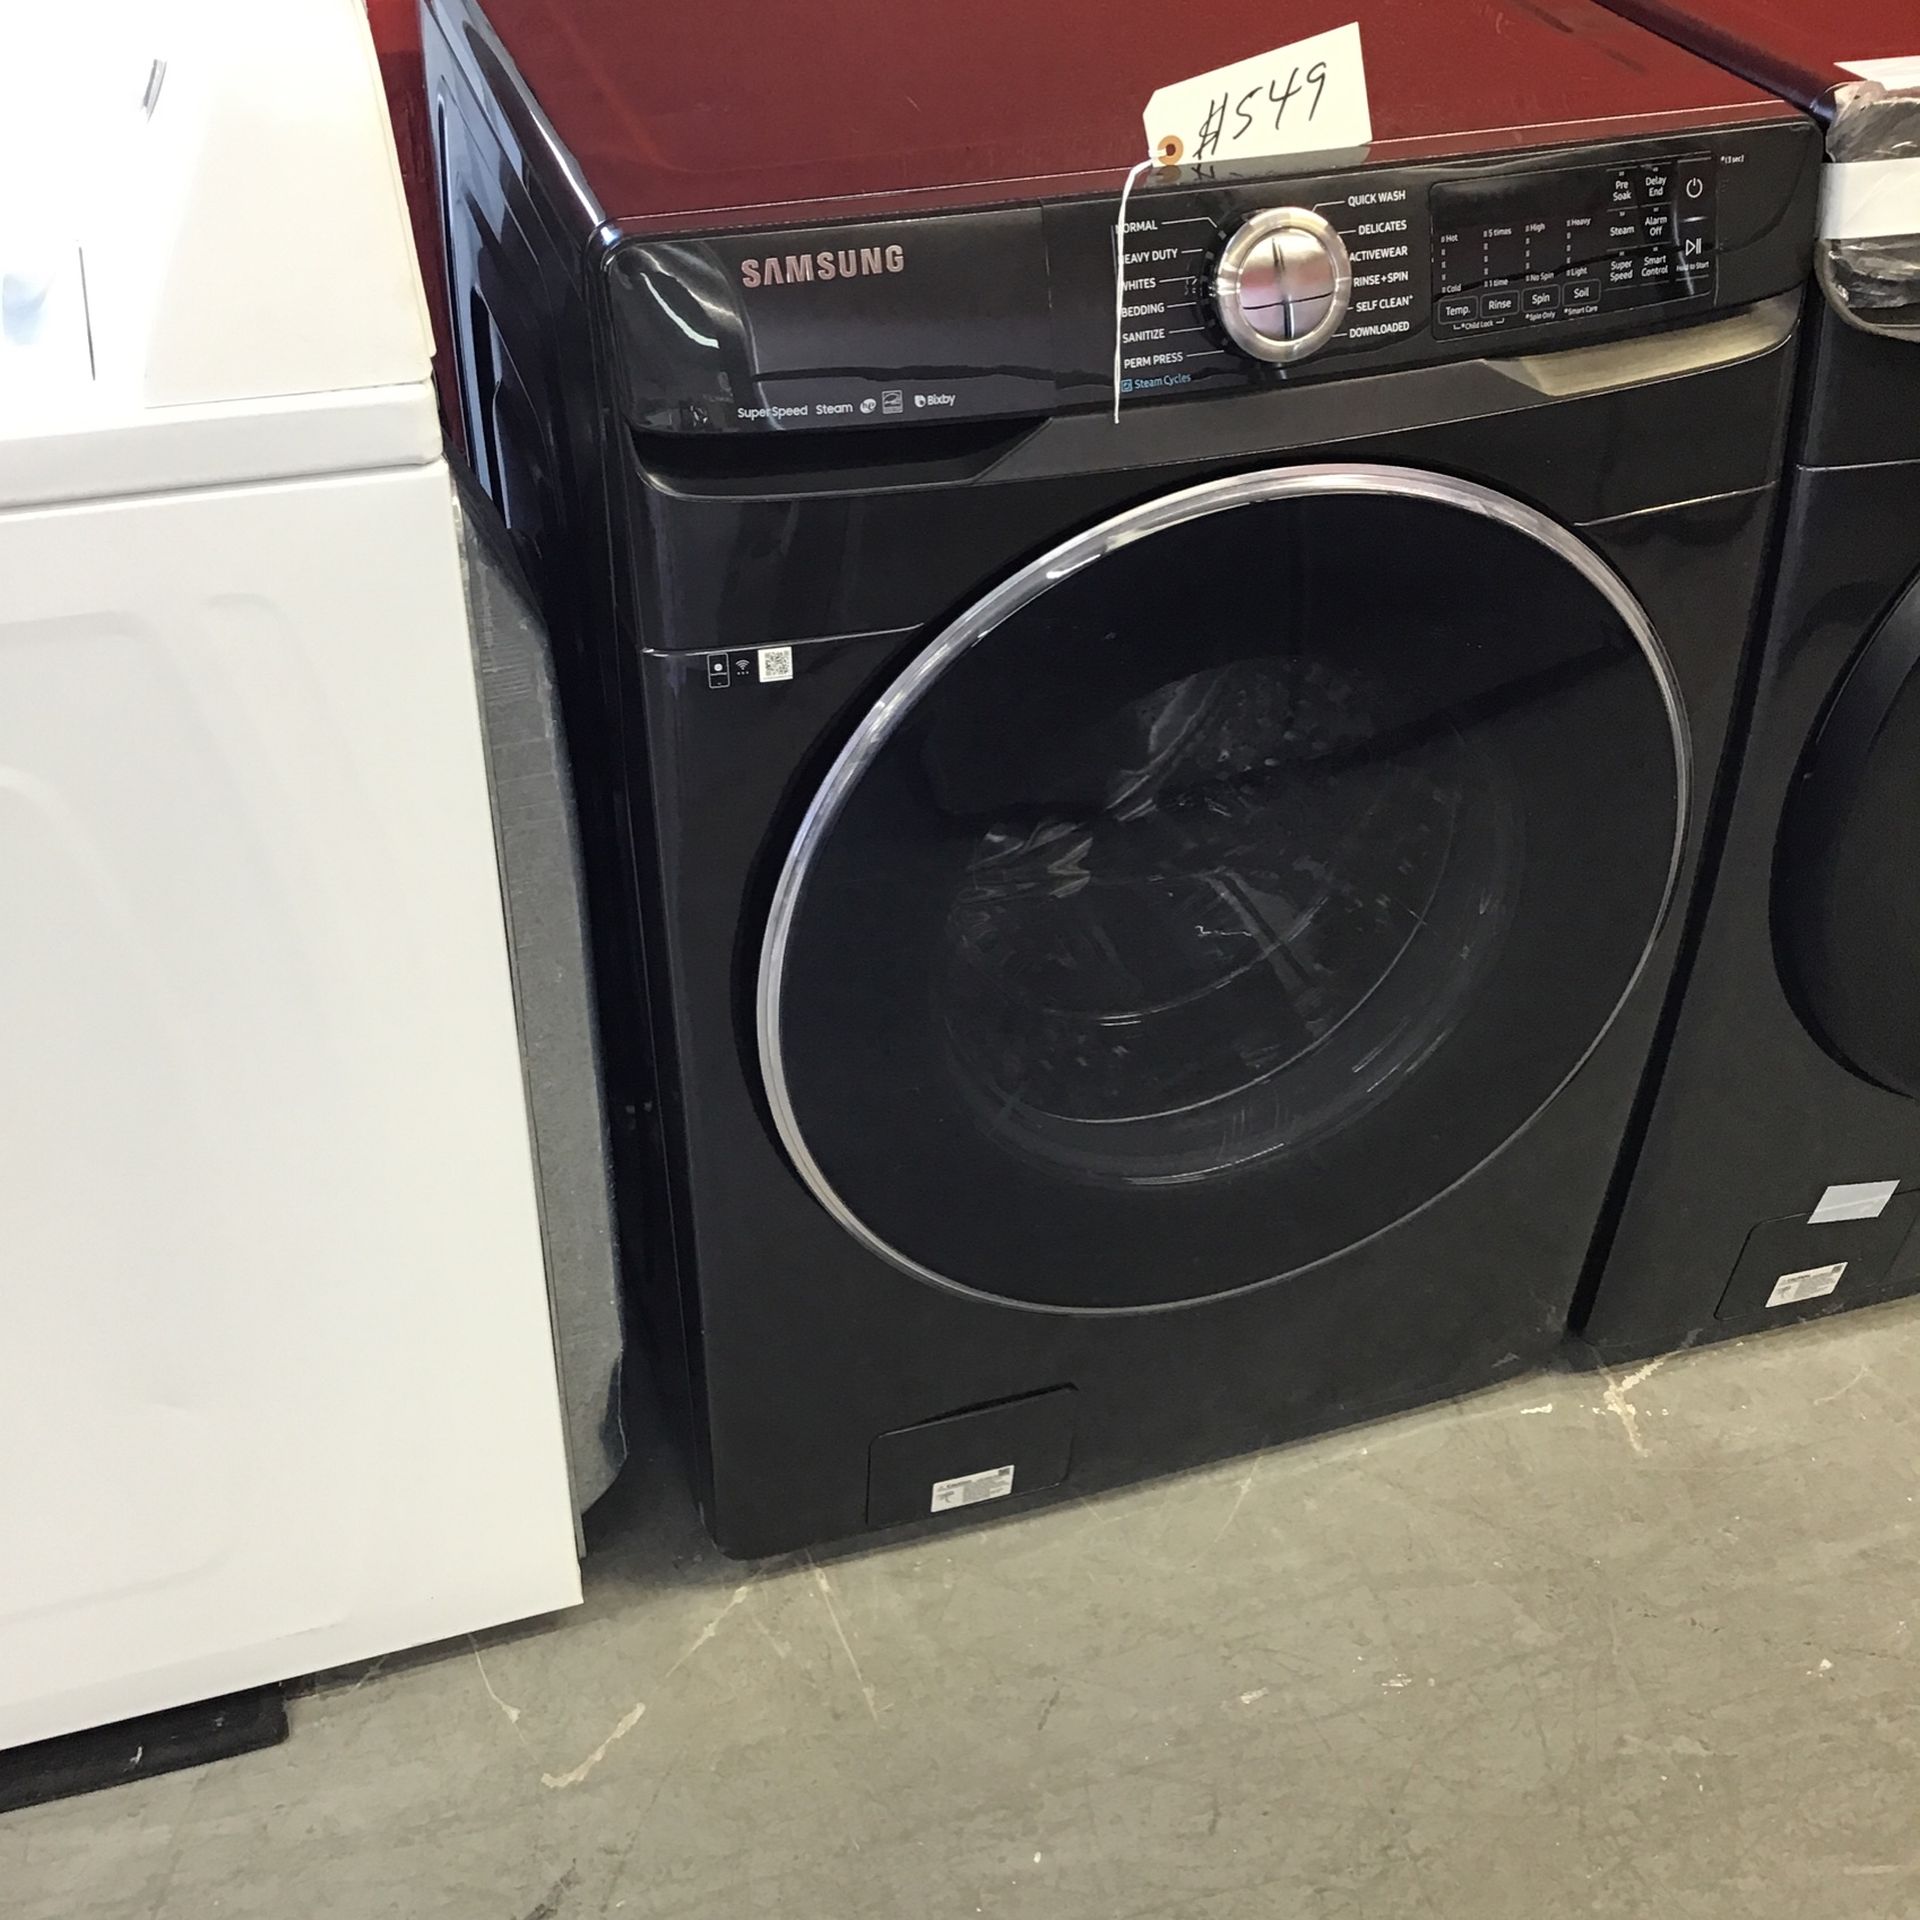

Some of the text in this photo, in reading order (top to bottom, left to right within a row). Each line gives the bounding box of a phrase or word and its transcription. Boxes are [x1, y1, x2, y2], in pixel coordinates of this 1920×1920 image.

[1615, 180, 1629, 190] Pre
[1645, 176, 1667, 186] Delay
[1612, 190, 1632, 201] Soak
[1648, 186, 1664, 197] End
[1347, 189, 1406, 207] QUICK WASH
[1571, 218, 1592, 226] Heavy
[1644, 216, 1668, 226] Alarm
[1358, 219, 1407, 235] DELICATES
[1488, 227, 1512, 238] 5 times
[1530, 222, 1546, 233] High
[1610, 226, 1635, 236] Steam
[1649, 225, 1663, 236] Off
[1445, 234, 1459, 242] Hot
[1118, 247, 1178, 265] EAVY DUTY
[1348, 245, 1408, 262] ACTIVEWEAR
[741, 244, 905, 288] SAMSUNG
[1610, 260, 1633, 271] Super
[1643, 255, 1667, 266] Smart
[1530, 271, 1555, 281] No Spin
[1570, 266, 1588, 277] Light
[1609, 269, 1634, 282] Speed
[1641, 264, 1669, 277] Control
[1446, 283, 1462, 293] Cold
[1493, 279, 1509, 287] time
[1531, 292, 1551, 305] Spin
[1573, 287, 1590, 299] Soil
[1120, 302, 1165, 318] BEDDING
[1355, 299, 1378, 312] SELF
[1488, 299, 1512, 310] Rinse
[1445, 305, 1471, 316] Temp.
[1480, 319, 1494, 328] Lock
[1349, 321, 1410, 338] DOWNLOADED
[1122, 328, 1166, 344] SANITIZE
[1123, 351, 1184, 369] PERM PRESS
[1134, 372, 1192, 389] Steam Cycles
[927, 393, 956, 407] Bixby
[815, 402, 853, 415] Steam
